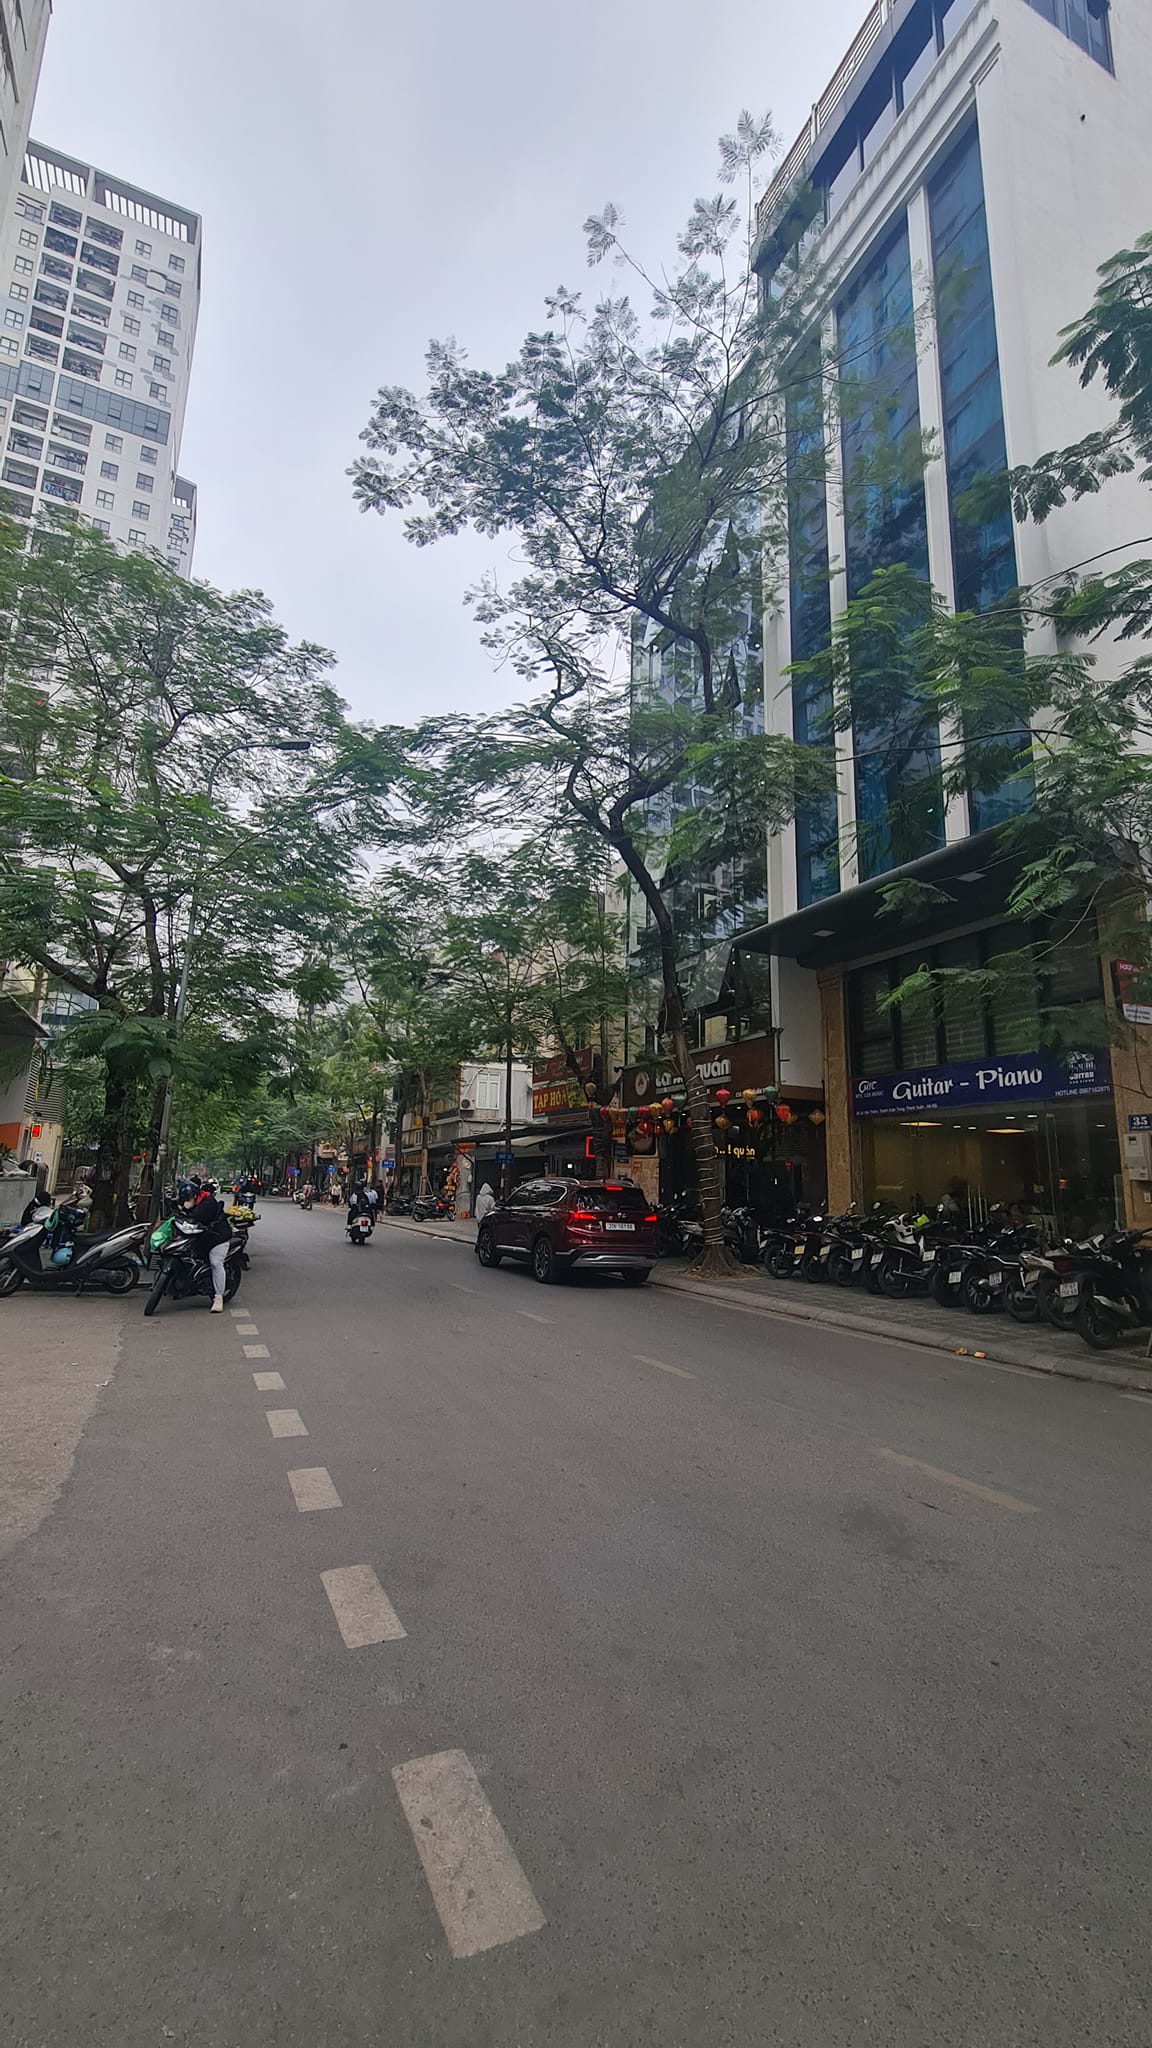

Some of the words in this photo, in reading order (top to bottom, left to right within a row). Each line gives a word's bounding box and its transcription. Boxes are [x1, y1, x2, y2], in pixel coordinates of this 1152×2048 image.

[892, 1077, 954, 1100] Guitar
[975, 1066, 1043, 1090] Piano
[1132, 1116, 1149, 1126] 35
